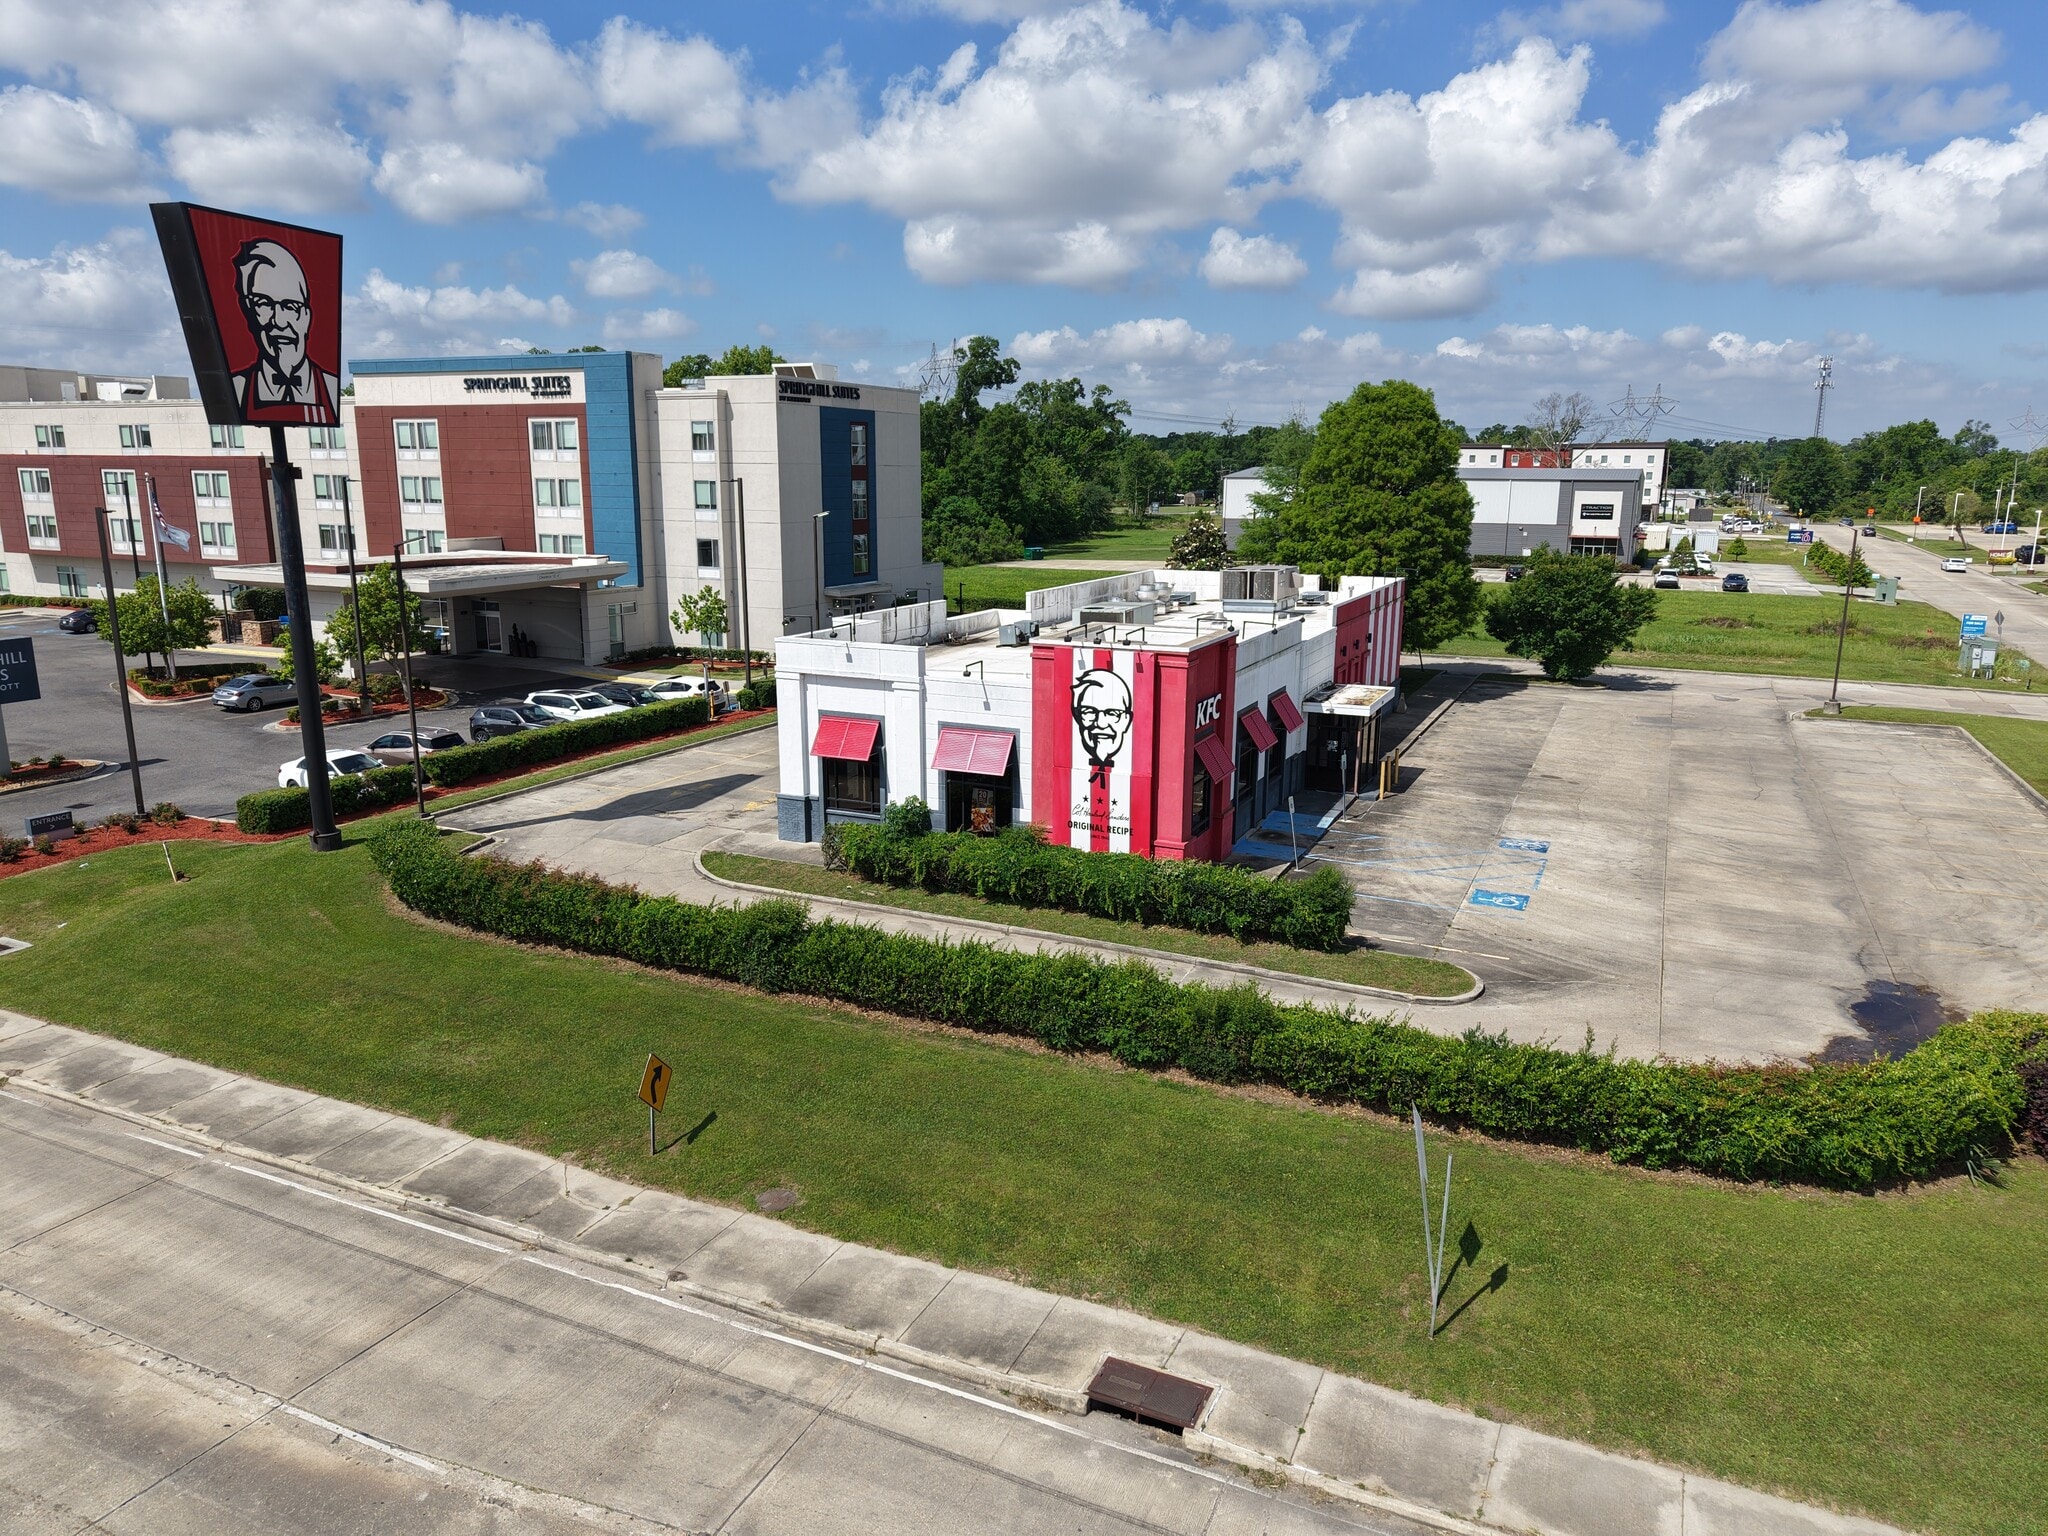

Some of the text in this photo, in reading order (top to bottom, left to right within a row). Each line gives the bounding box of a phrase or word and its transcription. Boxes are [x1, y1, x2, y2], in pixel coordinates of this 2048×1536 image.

[463, 376, 571, 391] SPRINGHILL SUITES
[779, 380, 860, 400] SPRINGHILL SUITES
[1196, 693, 1222, 730] KFC
[32, 813, 71, 827] ENTRANCE
[1067, 820, 1134, 836] ORIGINAL RECIPE
